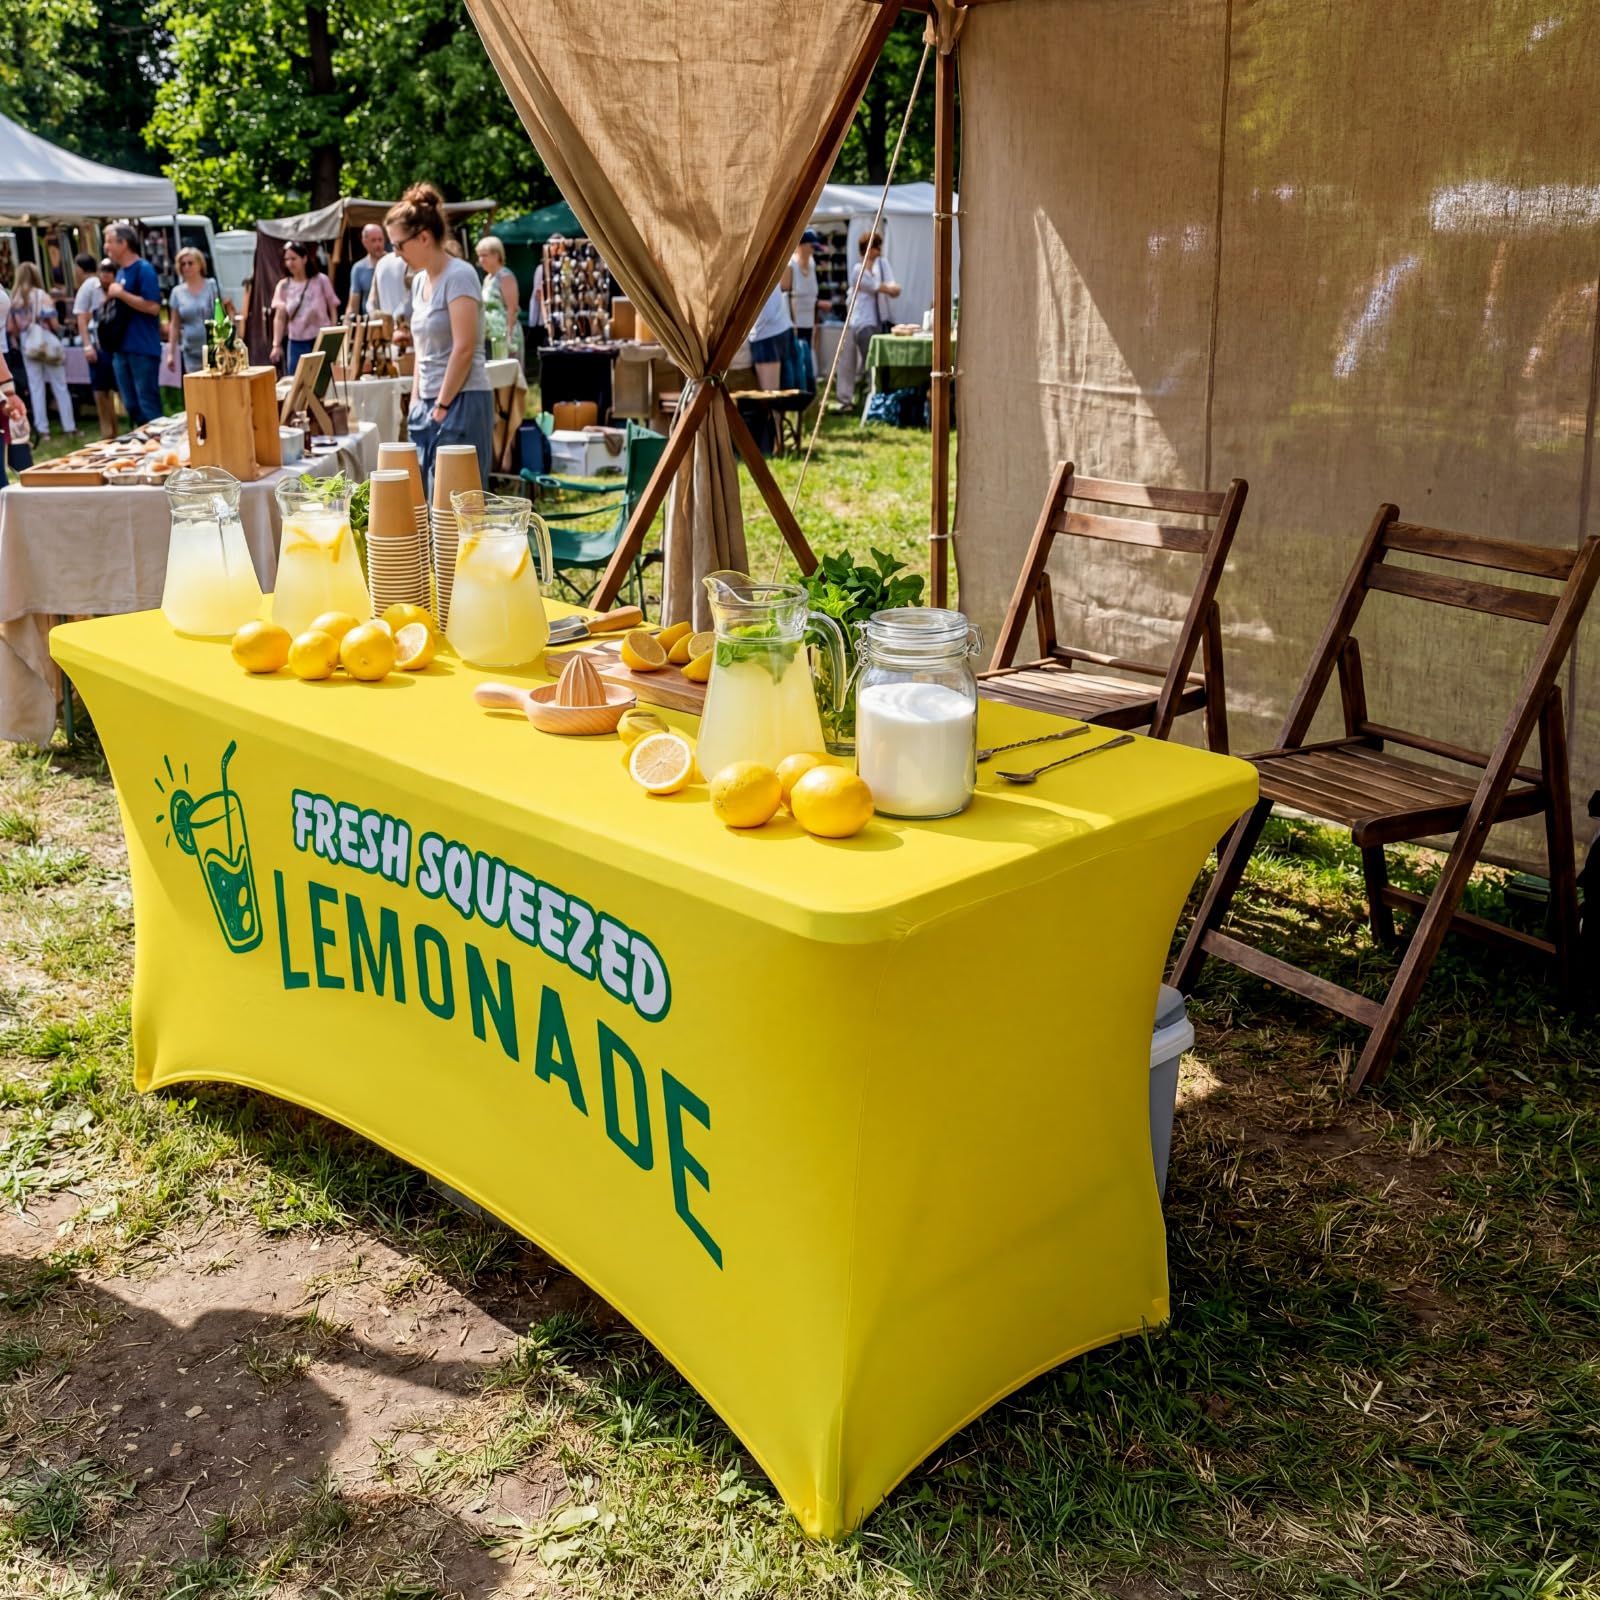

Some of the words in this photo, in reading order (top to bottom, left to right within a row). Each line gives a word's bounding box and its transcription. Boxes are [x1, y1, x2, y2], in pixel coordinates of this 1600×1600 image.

[291, 788, 410, 888] FRESH
[417, 831, 672, 1023] SQUEEZED
[272, 868, 723, 1271] LEMONADE
